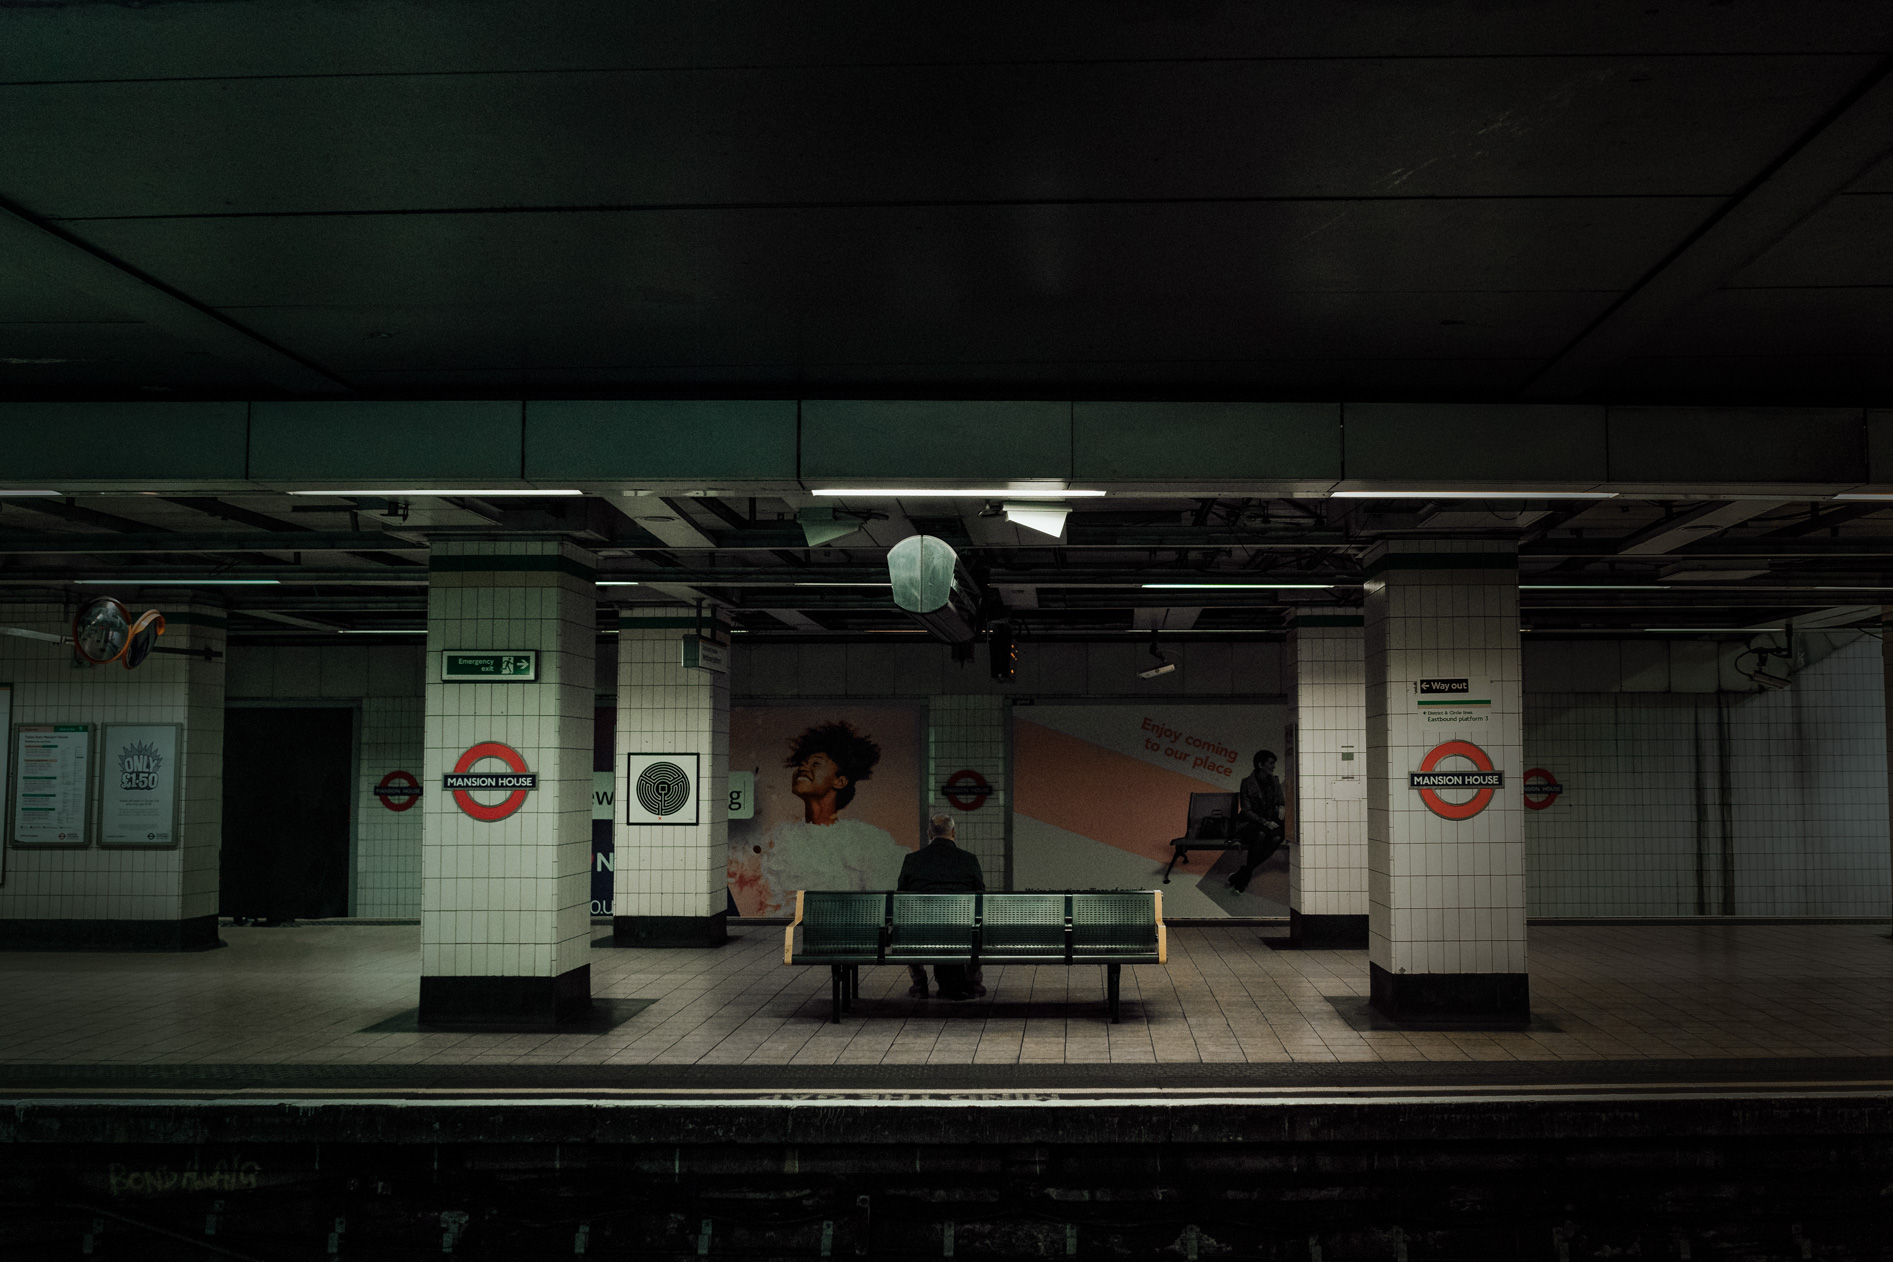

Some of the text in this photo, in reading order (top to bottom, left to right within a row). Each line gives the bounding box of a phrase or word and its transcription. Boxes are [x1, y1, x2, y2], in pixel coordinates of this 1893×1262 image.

[458, 657, 494, 666] Emergency
[1431, 681, 1467, 692] Way out
[1141, 717, 1239, 764] Enjoy coming
[1144, 737, 1233, 777] to our place
[124, 754, 158, 772] ONLY
[447, 777, 533, 787] MANSION HOUSE
[1413, 775, 1500, 785] MANSION HOUSE
